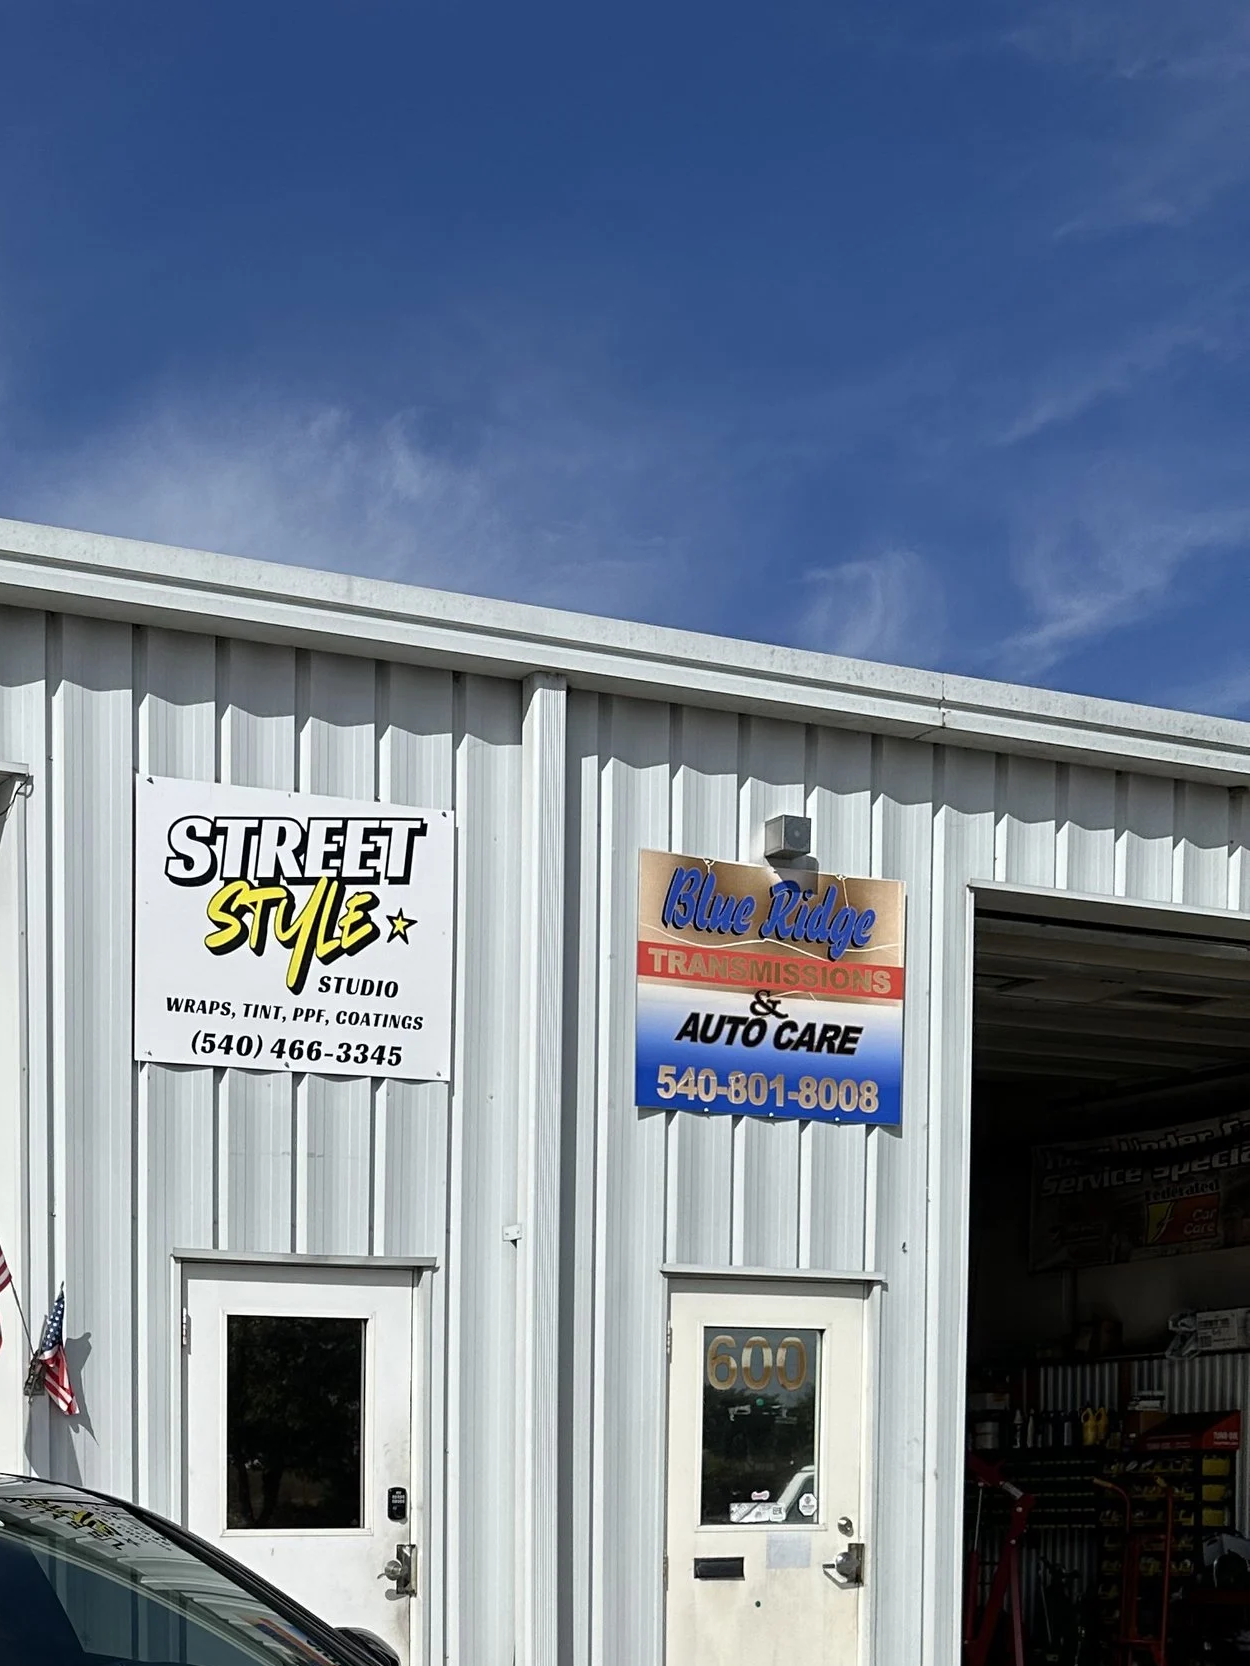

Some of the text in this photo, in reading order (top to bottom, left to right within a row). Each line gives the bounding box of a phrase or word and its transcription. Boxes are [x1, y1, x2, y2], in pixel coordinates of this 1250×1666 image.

[165, 815, 428, 887] STREET
[662, 867, 876, 961] Blue Ridge
[318, 976, 399, 998] STUDIO
[648, 947, 892, 994] TRANSMISSIONS
[166, 997, 424, 1030] WRAPS, TINT, PPF, COATINGS
[749, 989, 789, 1019] &
[191, 1029, 403, 1067] (540) 466-3345
[675, 1012, 864, 1055] AUTO CARE
[656, 1064, 880, 1113] 540-801-8008
[1041, 1165, 1143, 1197] Service
[1183, 1222, 1216, 1236] Care
[1192, 1208, 1217, 1222] Car
[707, 1335, 808, 1391] 600
